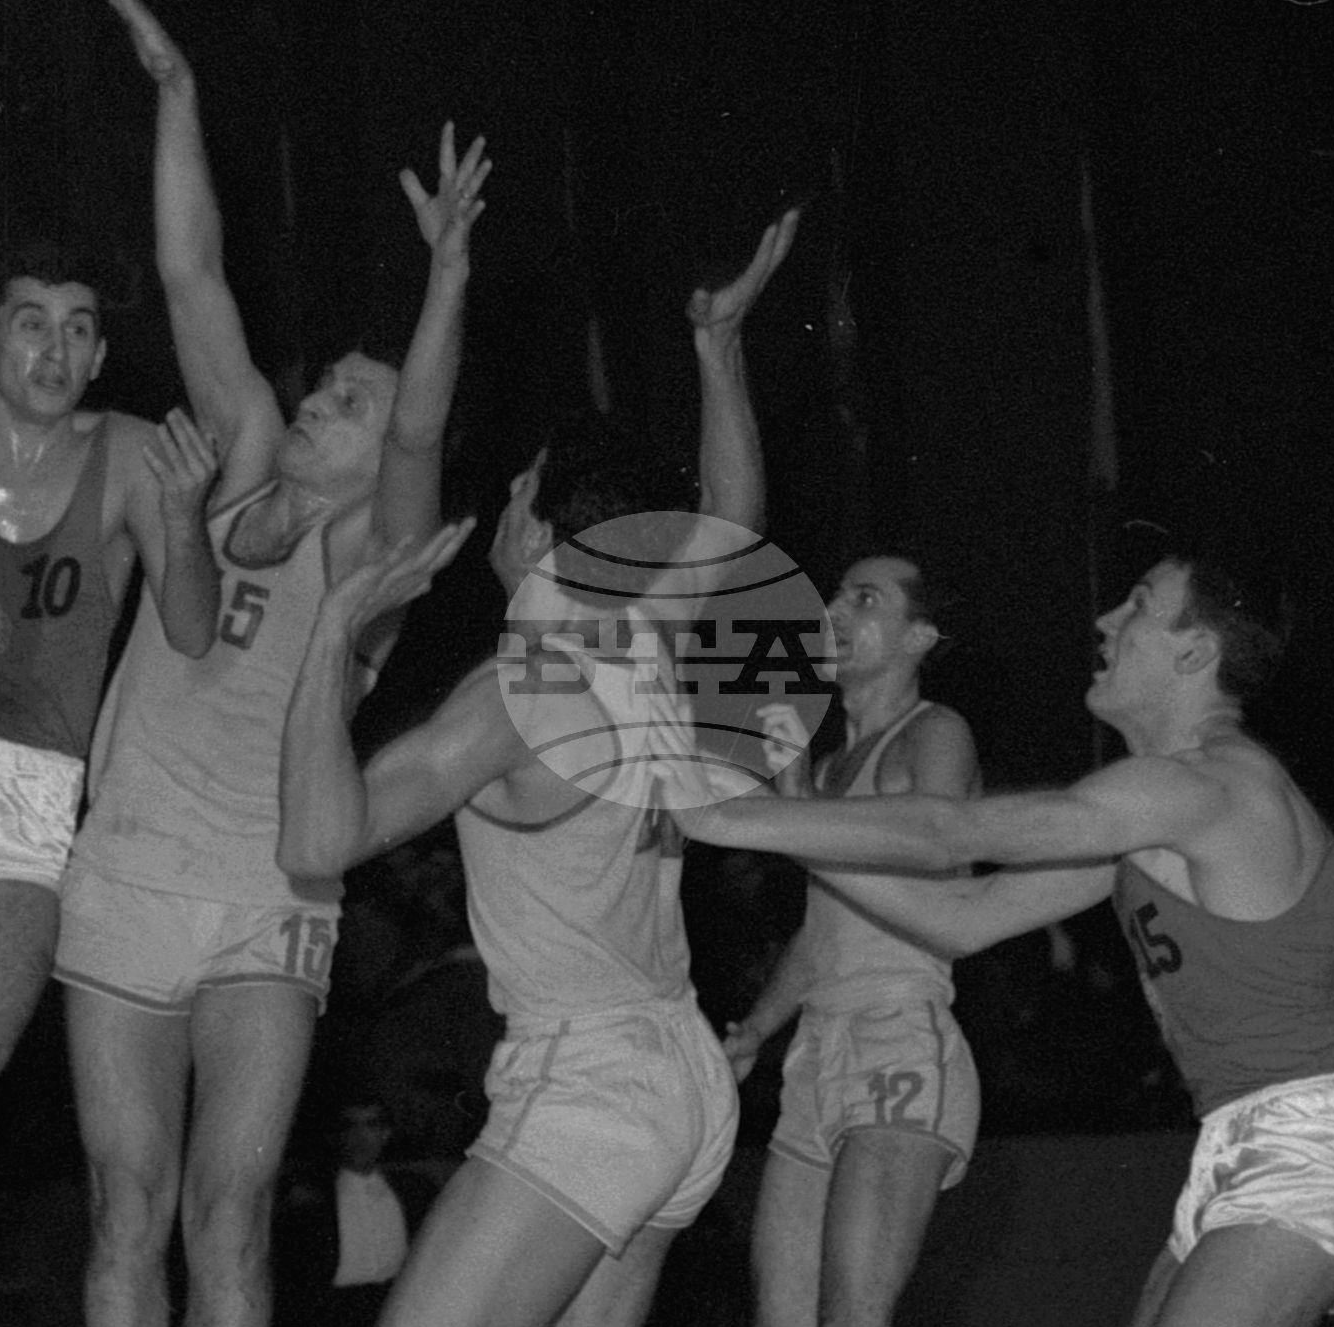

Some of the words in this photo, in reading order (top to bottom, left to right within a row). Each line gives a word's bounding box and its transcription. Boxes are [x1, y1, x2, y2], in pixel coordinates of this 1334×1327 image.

[21, 554, 81, 619] 10
[279, 913, 332, 980] 15
[868, 1071, 927, 1126] 12
